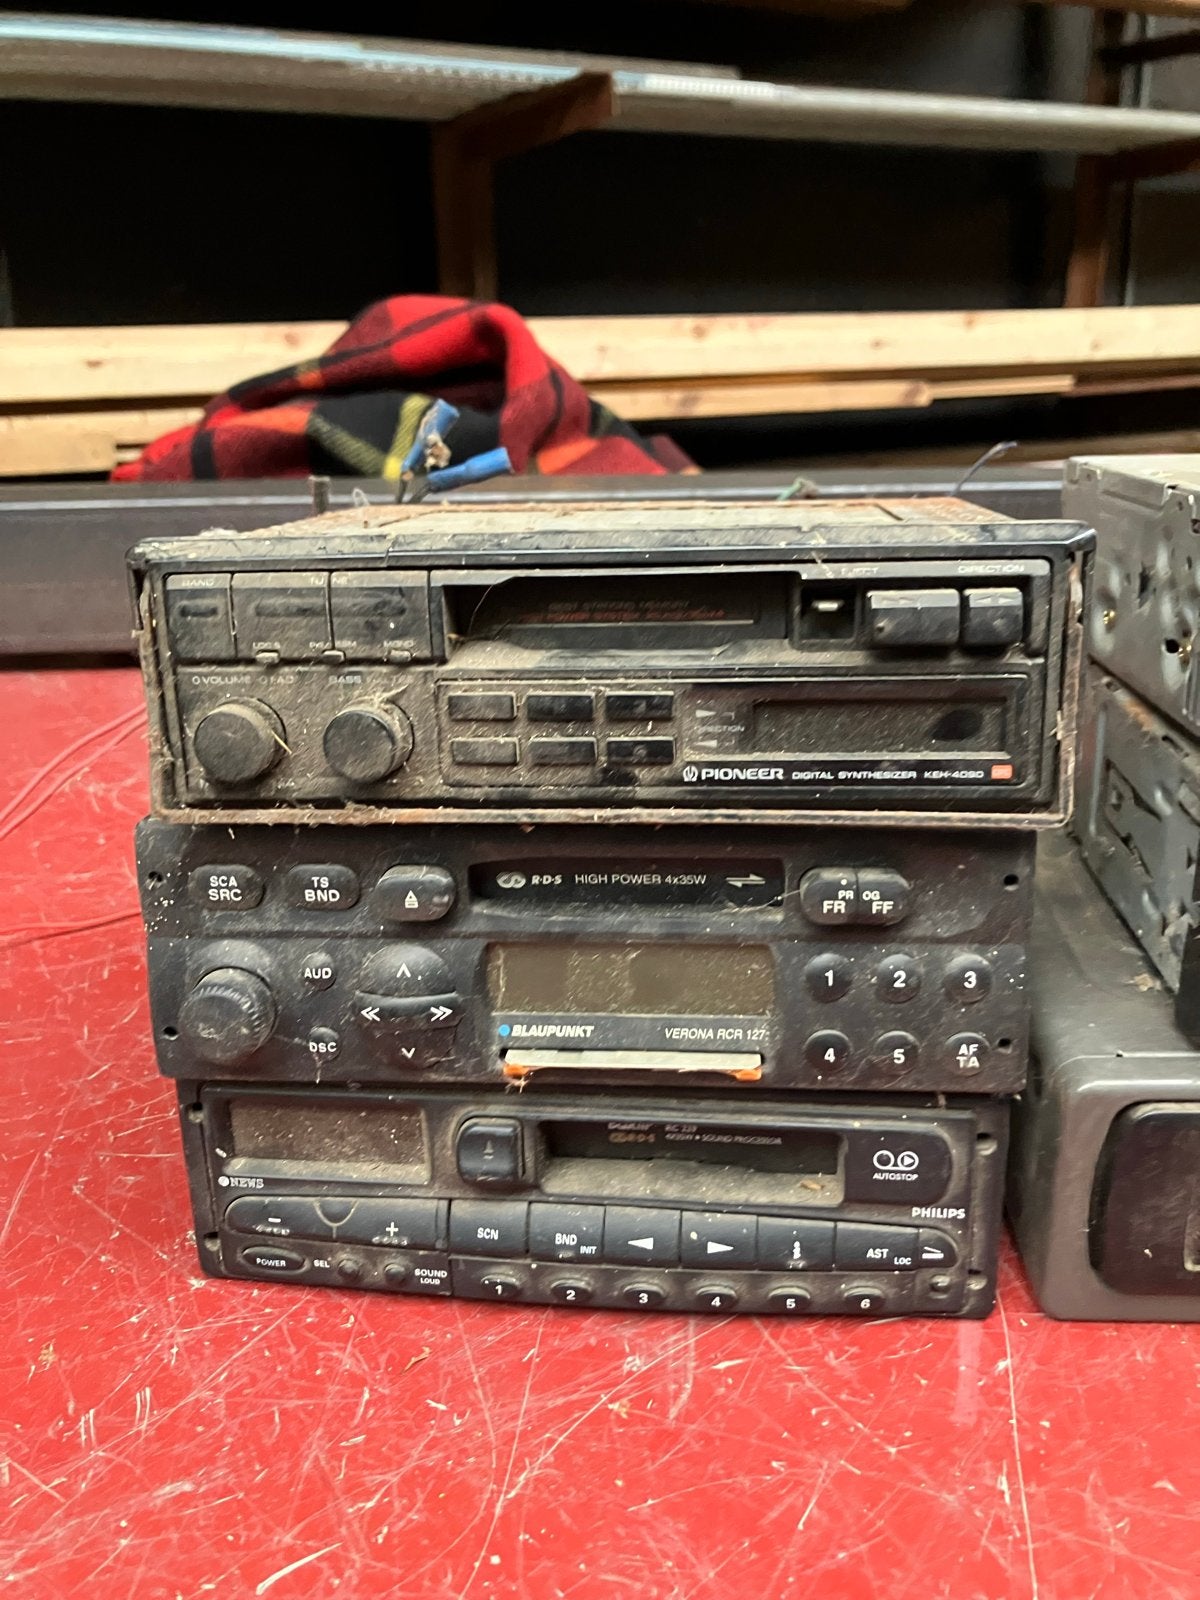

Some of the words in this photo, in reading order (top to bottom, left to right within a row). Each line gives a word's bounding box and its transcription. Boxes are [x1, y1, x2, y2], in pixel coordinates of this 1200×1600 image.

[701, 767, 784, 781] PIONEER
[791, 771, 835, 780] DIGITAL
[837, 770, 917, 780] SYNTHESIZER
[209, 875, 238, 888] SCA
[311, 875, 330, 889] TS
[574, 873, 608, 886] HIGH
[611, 873, 662, 886] POWER
[664, 874, 707, 886] 4x35W
[208, 888, 243, 902] SRC
[304, 888, 341, 902] BND
[837, 889, 855, 900] PR
[862, 890, 881, 900] OG
[822, 900, 847, 915] FR
[871, 900, 894, 915] FF
[303, 966, 332, 980] AUD
[823, 969, 834, 988] 1
[892, 969, 907, 989] 2
[963, 970, 978, 990] 3
[511, 1025, 594, 1038] BLAUPUNKT
[664, 1027, 715, 1041] VERONA
[716, 1028, 743, 1041] RCR
[308, 1041, 338, 1053] DSC
[958, 1043, 979, 1056] AF
[823, 1047, 836, 1064] 4
[892, 1048, 906, 1065] 5
[955, 1056, 980, 1069] TA
[230, 1176, 265, 1189] NEWS
[872, 1172, 919, 1181] AUTOSTOP
[911, 1206, 966, 1220] PHILIPS
[476, 1227, 499, 1241] SCN
[554, 1232, 578, 1246] BND
[579, 1244, 597, 1255] INIT
[866, 1248, 889, 1260] AST
[256, 1257, 287, 1268] POWER
[313, 1258, 331, 1269] SEL
[893, 1256, 912, 1266] LOC
[414, 1267, 448, 1279] SOUND
[420, 1277, 441, 1286] LOUD
[494, 1284, 503, 1296] 1
[566, 1289, 576, 1301] 2
[638, 1292, 649, 1305] 3
[710, 1297, 722, 1308] 4
[786, 1298, 796, 1309] 5
[860, 1298, 871, 1309] 6
